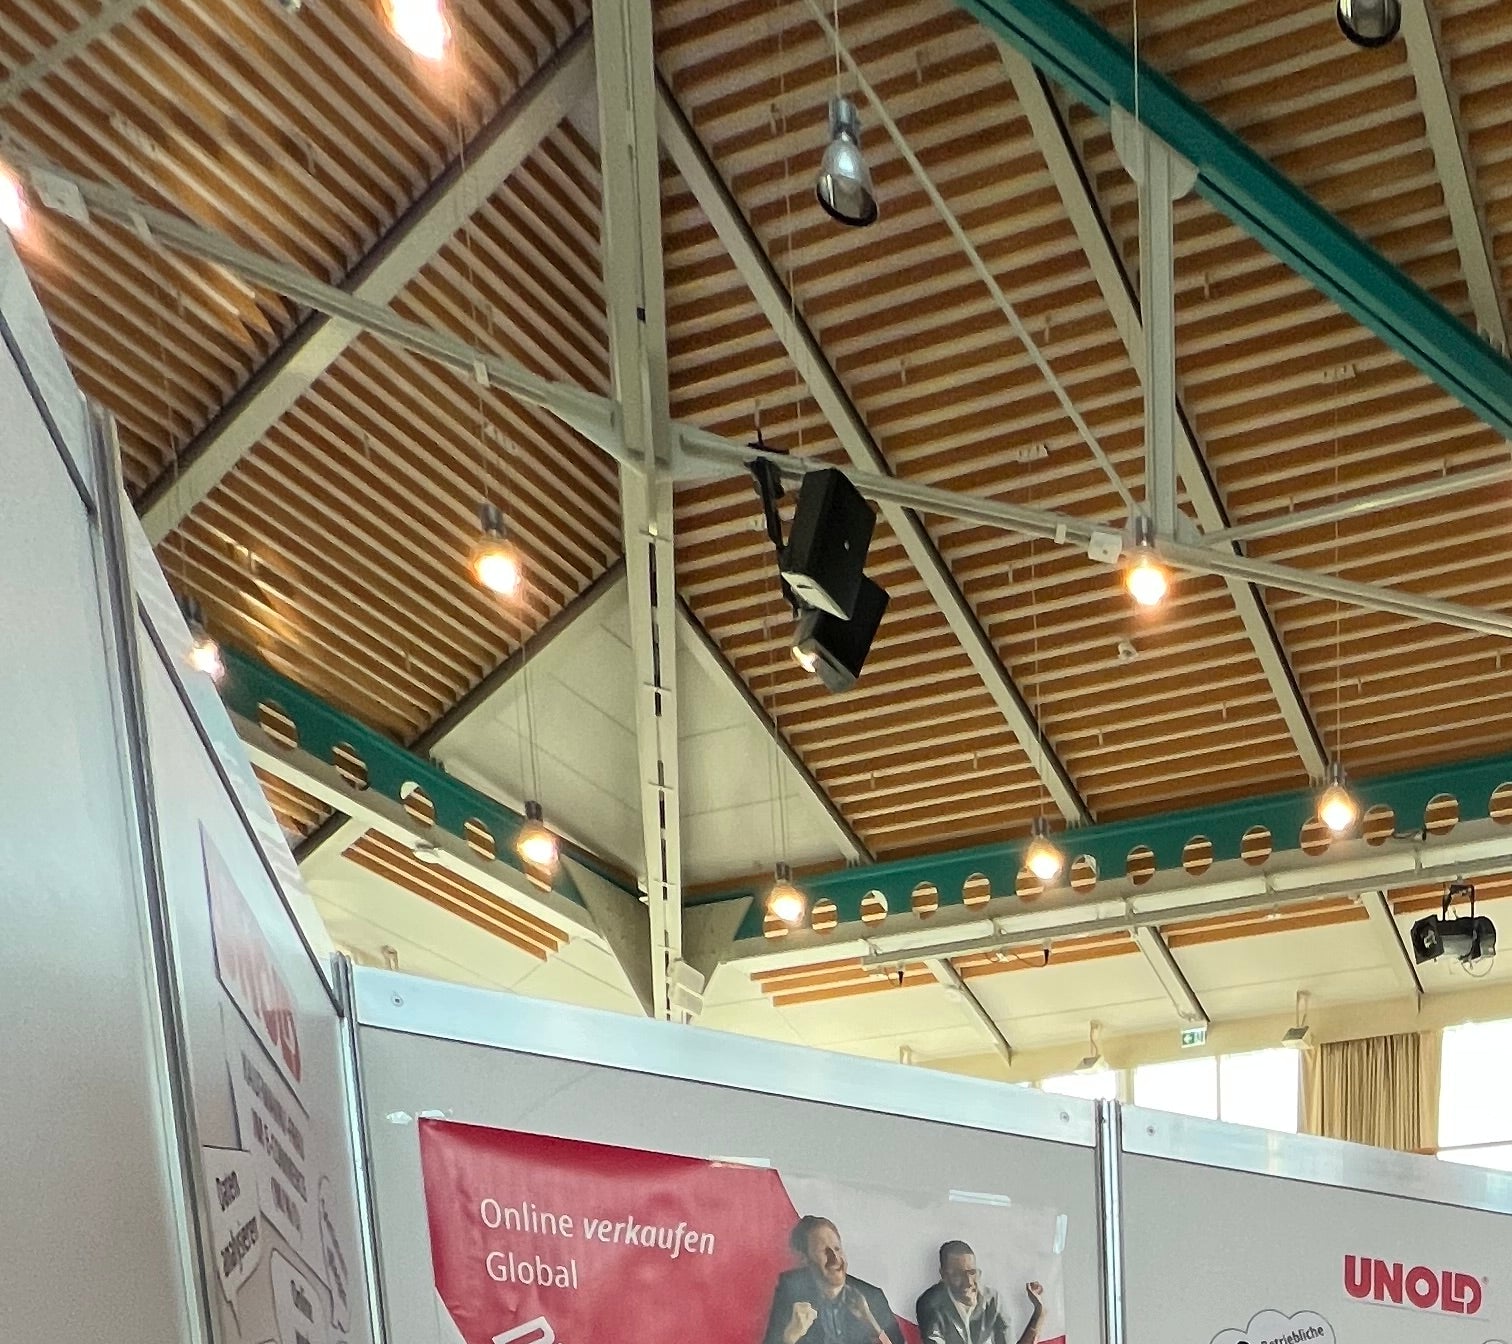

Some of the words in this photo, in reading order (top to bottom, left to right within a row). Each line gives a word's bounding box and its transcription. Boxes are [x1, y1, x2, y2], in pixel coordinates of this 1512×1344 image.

[480, 1197, 574, 1238] Online
[582, 1214, 716, 1256] verkaufen
[485, 1250, 580, 1290] Global
[1344, 1254, 1482, 1315] UNOLD
